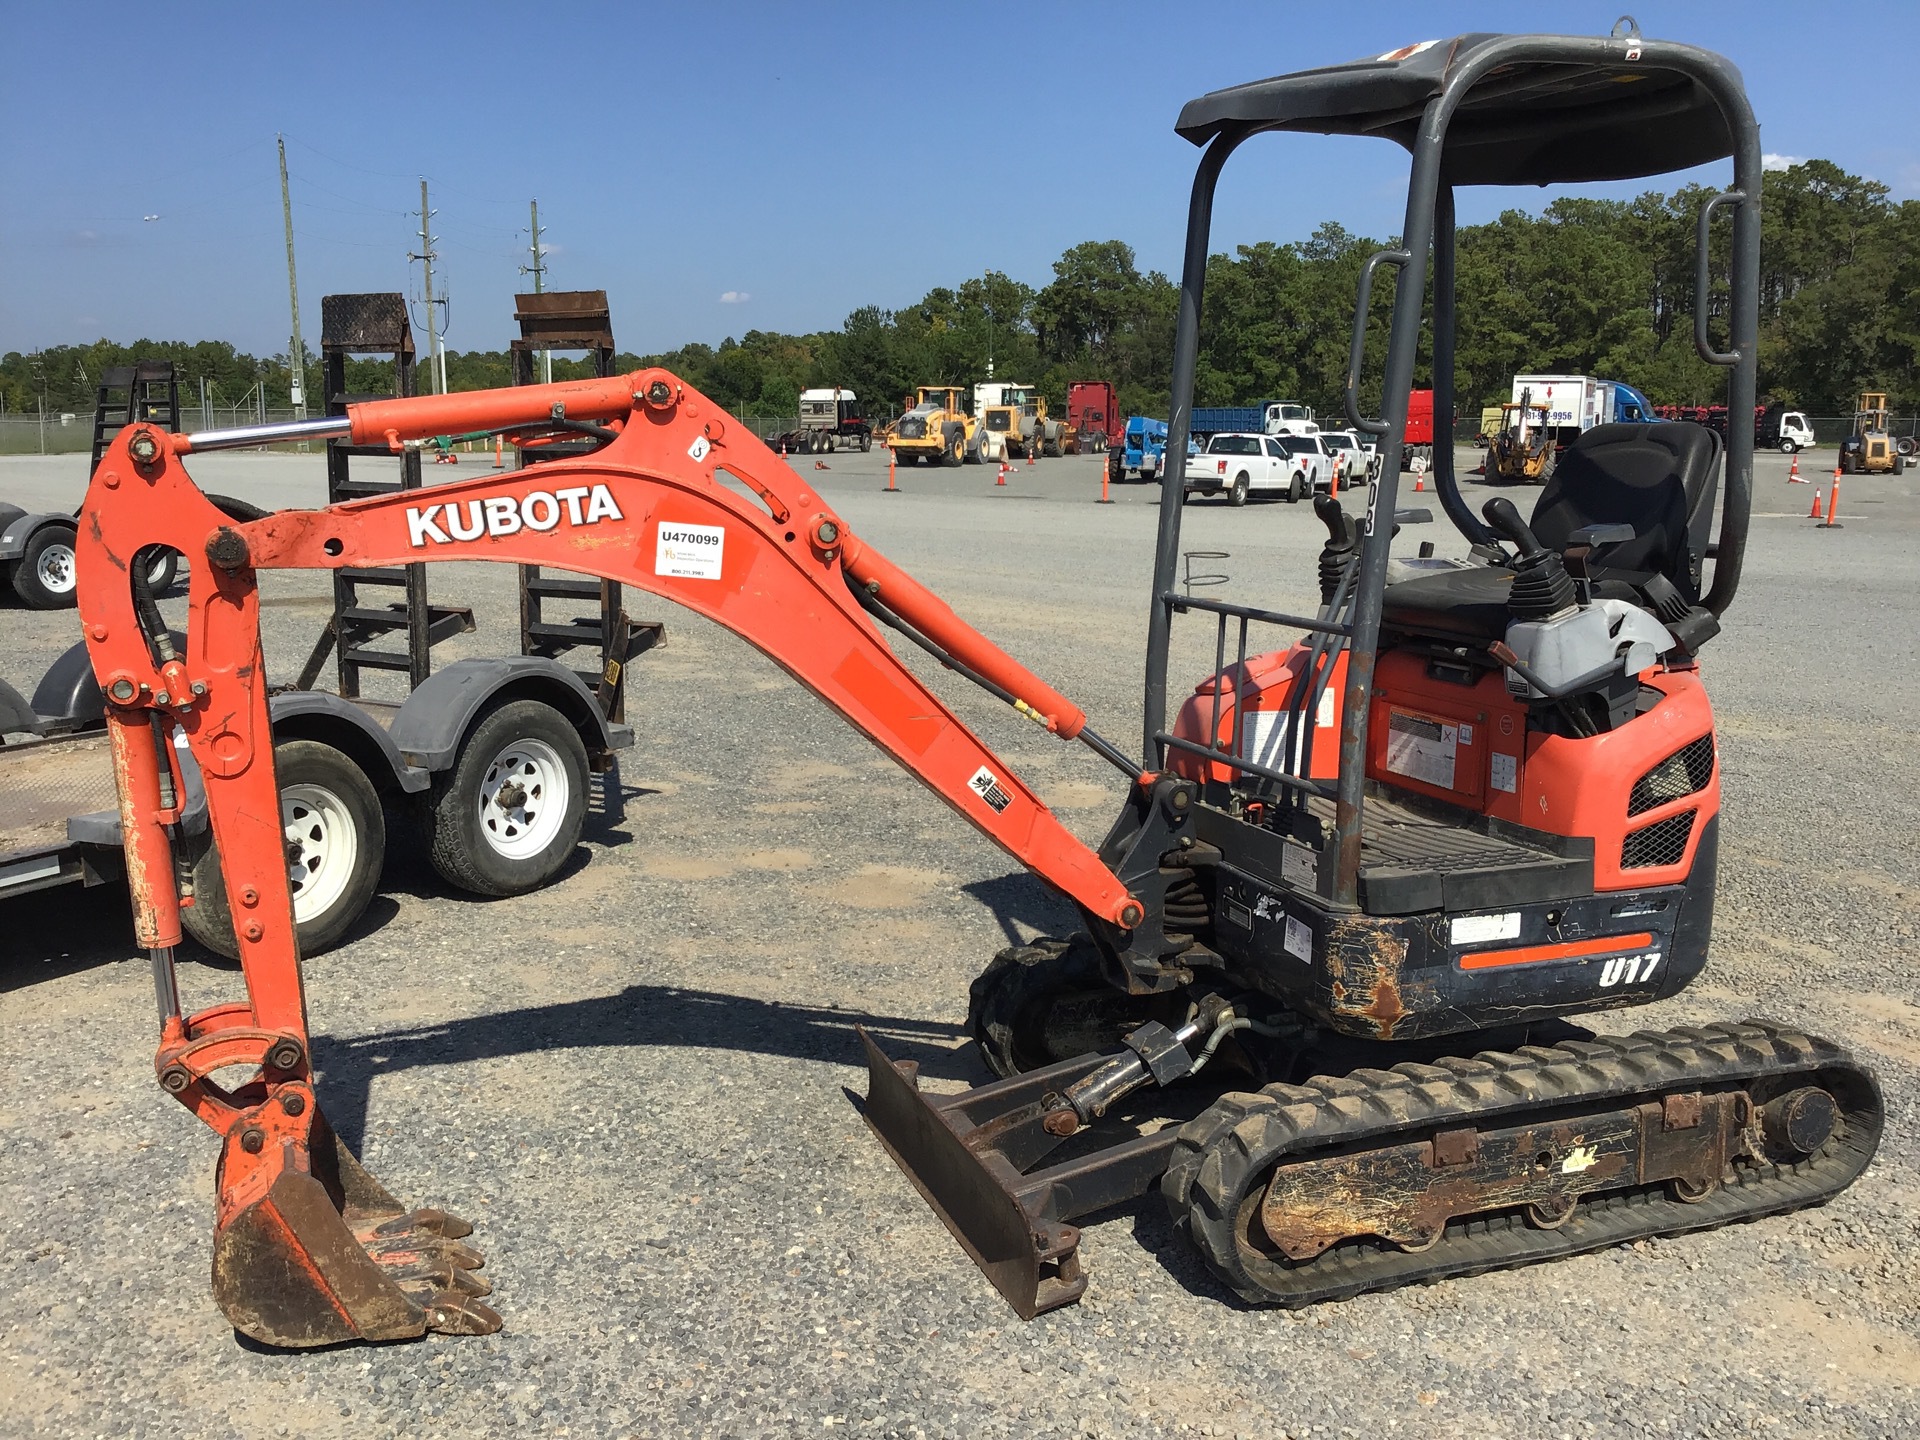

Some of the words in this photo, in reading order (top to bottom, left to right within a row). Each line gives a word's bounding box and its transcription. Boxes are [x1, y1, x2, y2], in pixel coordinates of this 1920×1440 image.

[406, 484, 624, 547] KUBOTA
[1365, 455, 1382, 534] 303
[662, 531, 719, 546] U470099
[1599, 952, 1662, 988] U17
